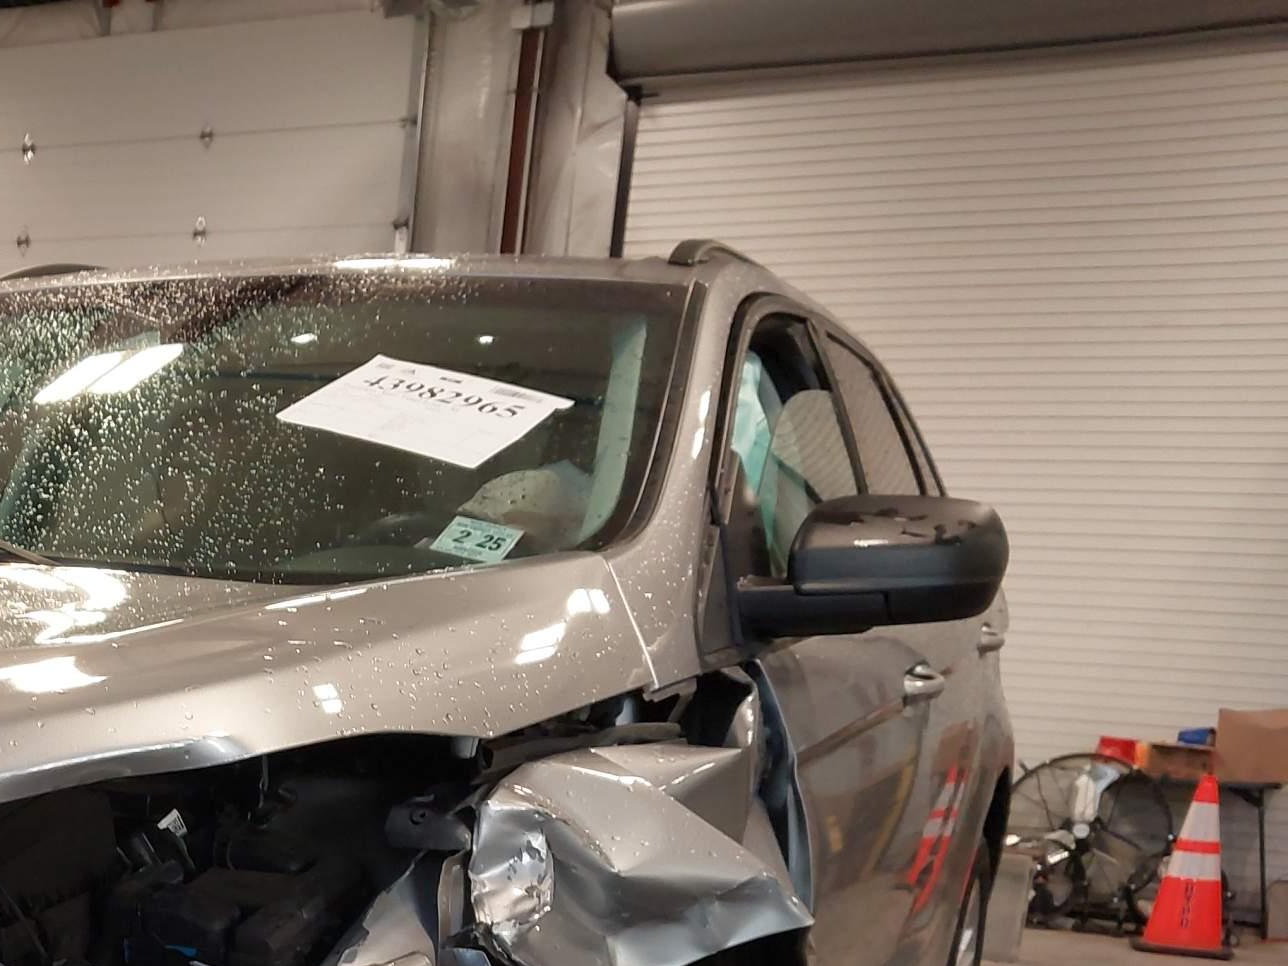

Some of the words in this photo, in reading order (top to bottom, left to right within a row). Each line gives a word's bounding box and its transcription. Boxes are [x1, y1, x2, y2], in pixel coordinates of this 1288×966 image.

[363, 375, 527, 419] 43982965
[452, 529, 473, 544] 2
[475, 534, 507, 551] 25
